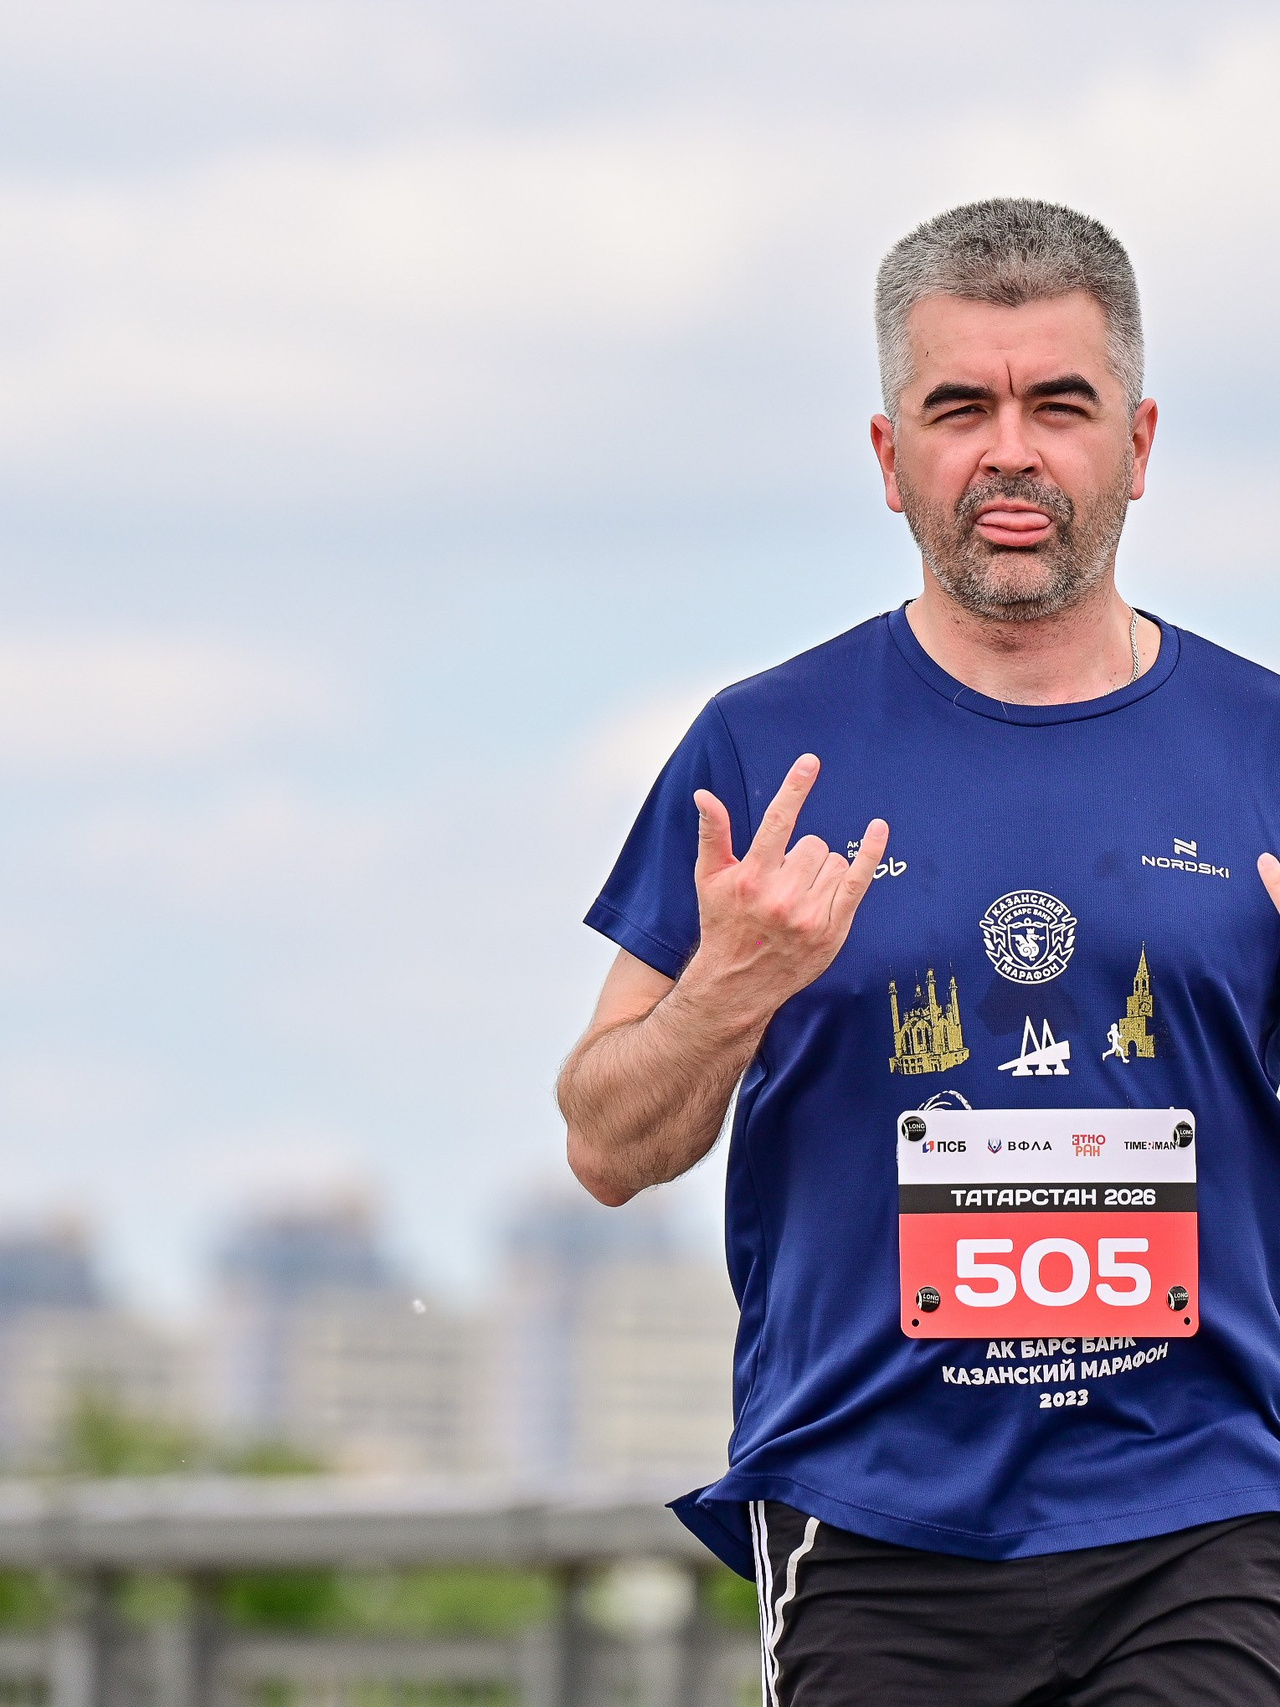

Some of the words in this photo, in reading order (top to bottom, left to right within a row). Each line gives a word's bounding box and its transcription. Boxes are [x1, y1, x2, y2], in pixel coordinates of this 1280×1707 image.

[1141, 855, 1230, 878] NORDSKI
[991, 894, 1064, 917] КАЗАНСКИЙ
[1001, 962, 1060, 980] МАРАФОН
[937, 1141, 967, 1153] ПСБ
[1008, 1140, 1052, 1151] ВФЛА
[1075, 1144, 1101, 1157] РАН
[951, 1189, 1097, 1206] ТАТАРСТАН
[1104, 1188, 1156, 1206] 2026
[954, 1237, 1152, 1308] 505
[986, 1341, 1016, 1360] АК
[1021, 1338, 1077, 1360] БАРС
[942, 1358, 1076, 1386] КАЗАНСКИЙ
[1080, 1342, 1169, 1380] МАРАФОН
[1039, 1389, 1089, 1409] 2023
